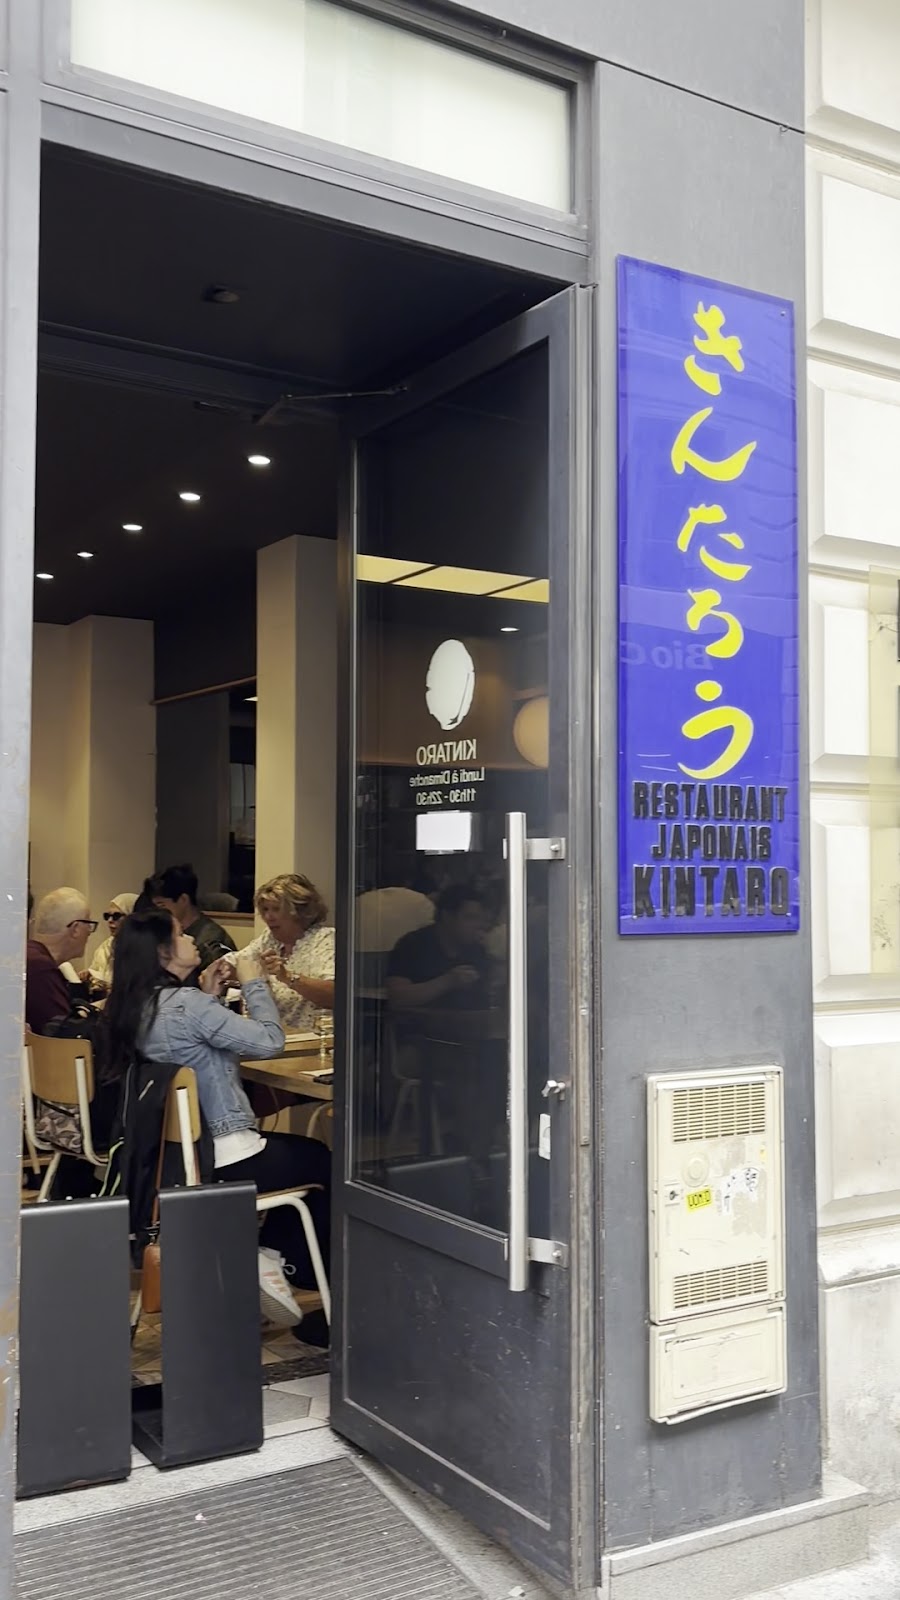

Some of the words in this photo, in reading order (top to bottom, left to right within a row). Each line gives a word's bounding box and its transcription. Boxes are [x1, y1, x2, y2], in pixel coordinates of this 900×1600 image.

[670, 300, 757, 780] きんたろう
[632, 780, 790, 822] RESTAURANT
[651, 822, 773, 861] JAPONAIS
[632, 863, 792, 919] KINTARO
